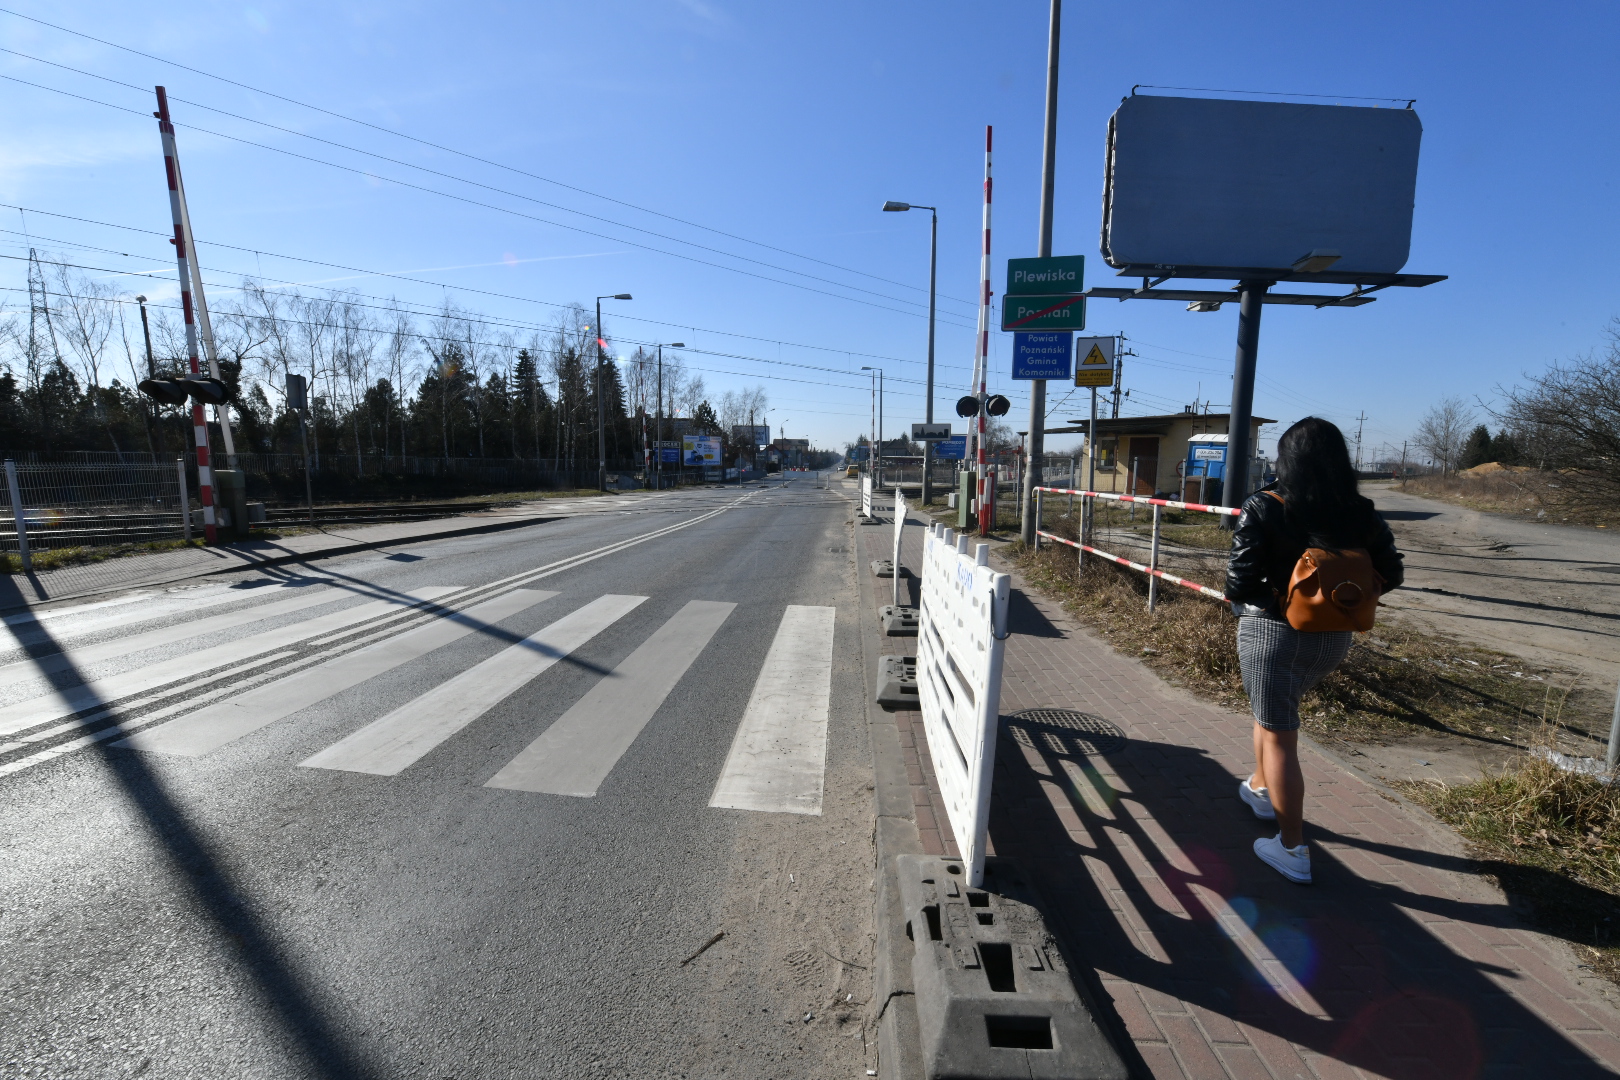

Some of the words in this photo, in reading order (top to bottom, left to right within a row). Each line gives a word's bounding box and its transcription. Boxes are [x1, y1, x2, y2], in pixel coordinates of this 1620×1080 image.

[1014, 269, 1076, 283] Plewiska
[1028, 334, 1058, 342] Powiat
[1020, 345, 1065, 354] Poznański
[1027, 357, 1057, 365] Gmina
[1018, 368, 1065, 376] Komorniki
